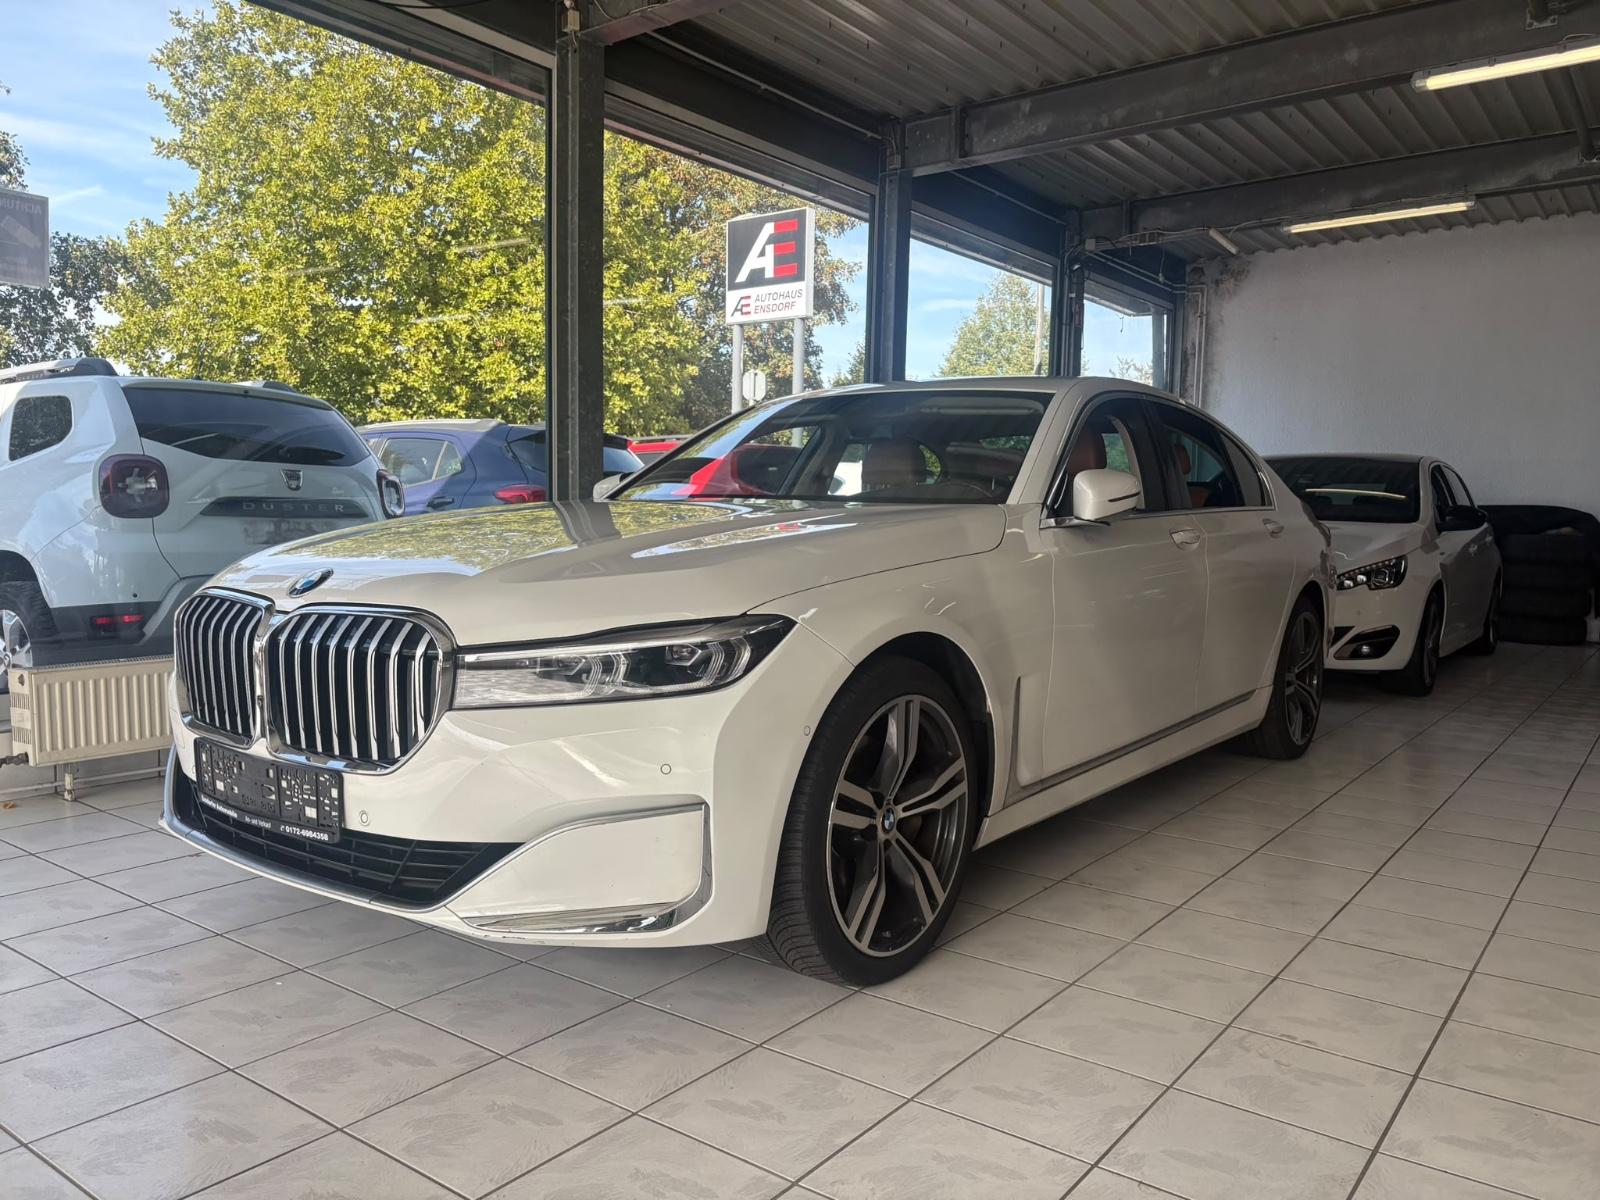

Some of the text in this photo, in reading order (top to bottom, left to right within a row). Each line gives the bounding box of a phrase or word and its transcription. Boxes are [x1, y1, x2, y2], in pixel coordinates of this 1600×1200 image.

[754, 288, 803, 303] AUTOHAUS
[754, 301, 797, 314] ENSDORF
[242, 502, 345, 513] DUSTER
